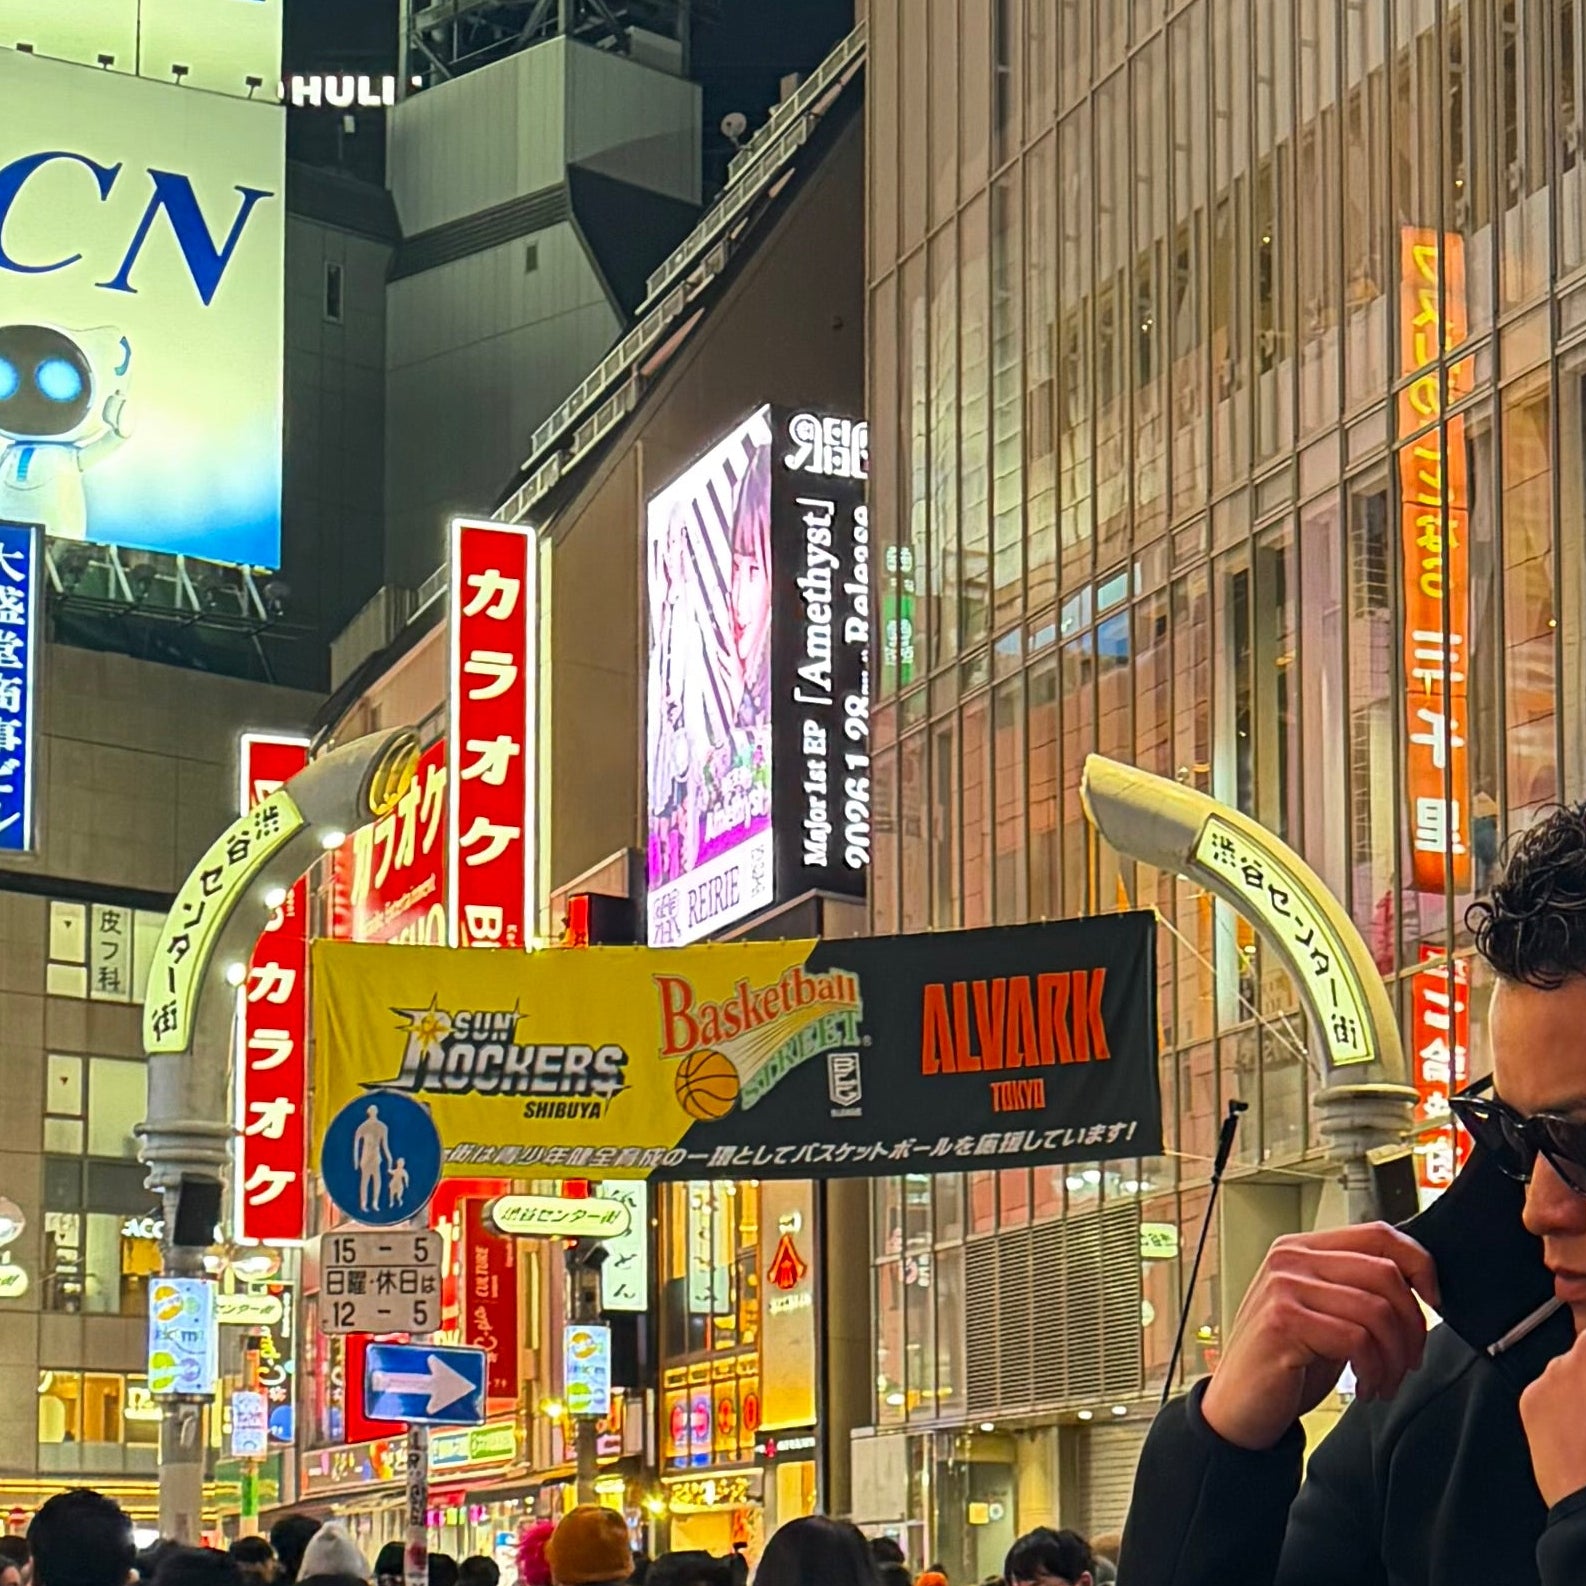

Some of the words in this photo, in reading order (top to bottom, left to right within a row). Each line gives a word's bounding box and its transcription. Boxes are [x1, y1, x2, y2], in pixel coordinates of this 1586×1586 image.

[291, 75, 421, 107] HULI
[460, 568, 521, 867] カラオケ
[803, 719, 827, 756] EP
[803, 759, 827, 795] 1st
[803, 796, 832, 867] Major
[150, 804, 282, 1041] 渋谷センター街
[688, 865, 740, 929] REIRIE
[98, 908, 123, 995] 皮フ科
[464, 904, 504, 948] BI
[1209, 831, 1358, 1050] 渋谷センター街
[452, 1010, 514, 1042] SUN
[653, 966, 857, 1057] Basketball
[920, 967, 1111, 1076] ALVARK
[375, 1006, 629, 1097] ROCKERS
[245, 962, 296, 1206] カラオケ
[523, 1100, 601, 1119] SHIBUYA
[989, 1078, 1046, 1112] TOKYO
[333, 1238, 356, 1264] 15
[414, 1237, 429, 1263] 5
[326, 1269, 436, 1296] 日曜・休日は
[333, 1301, 356, 1328] 12
[413, 1300, 428, 1326] 5
